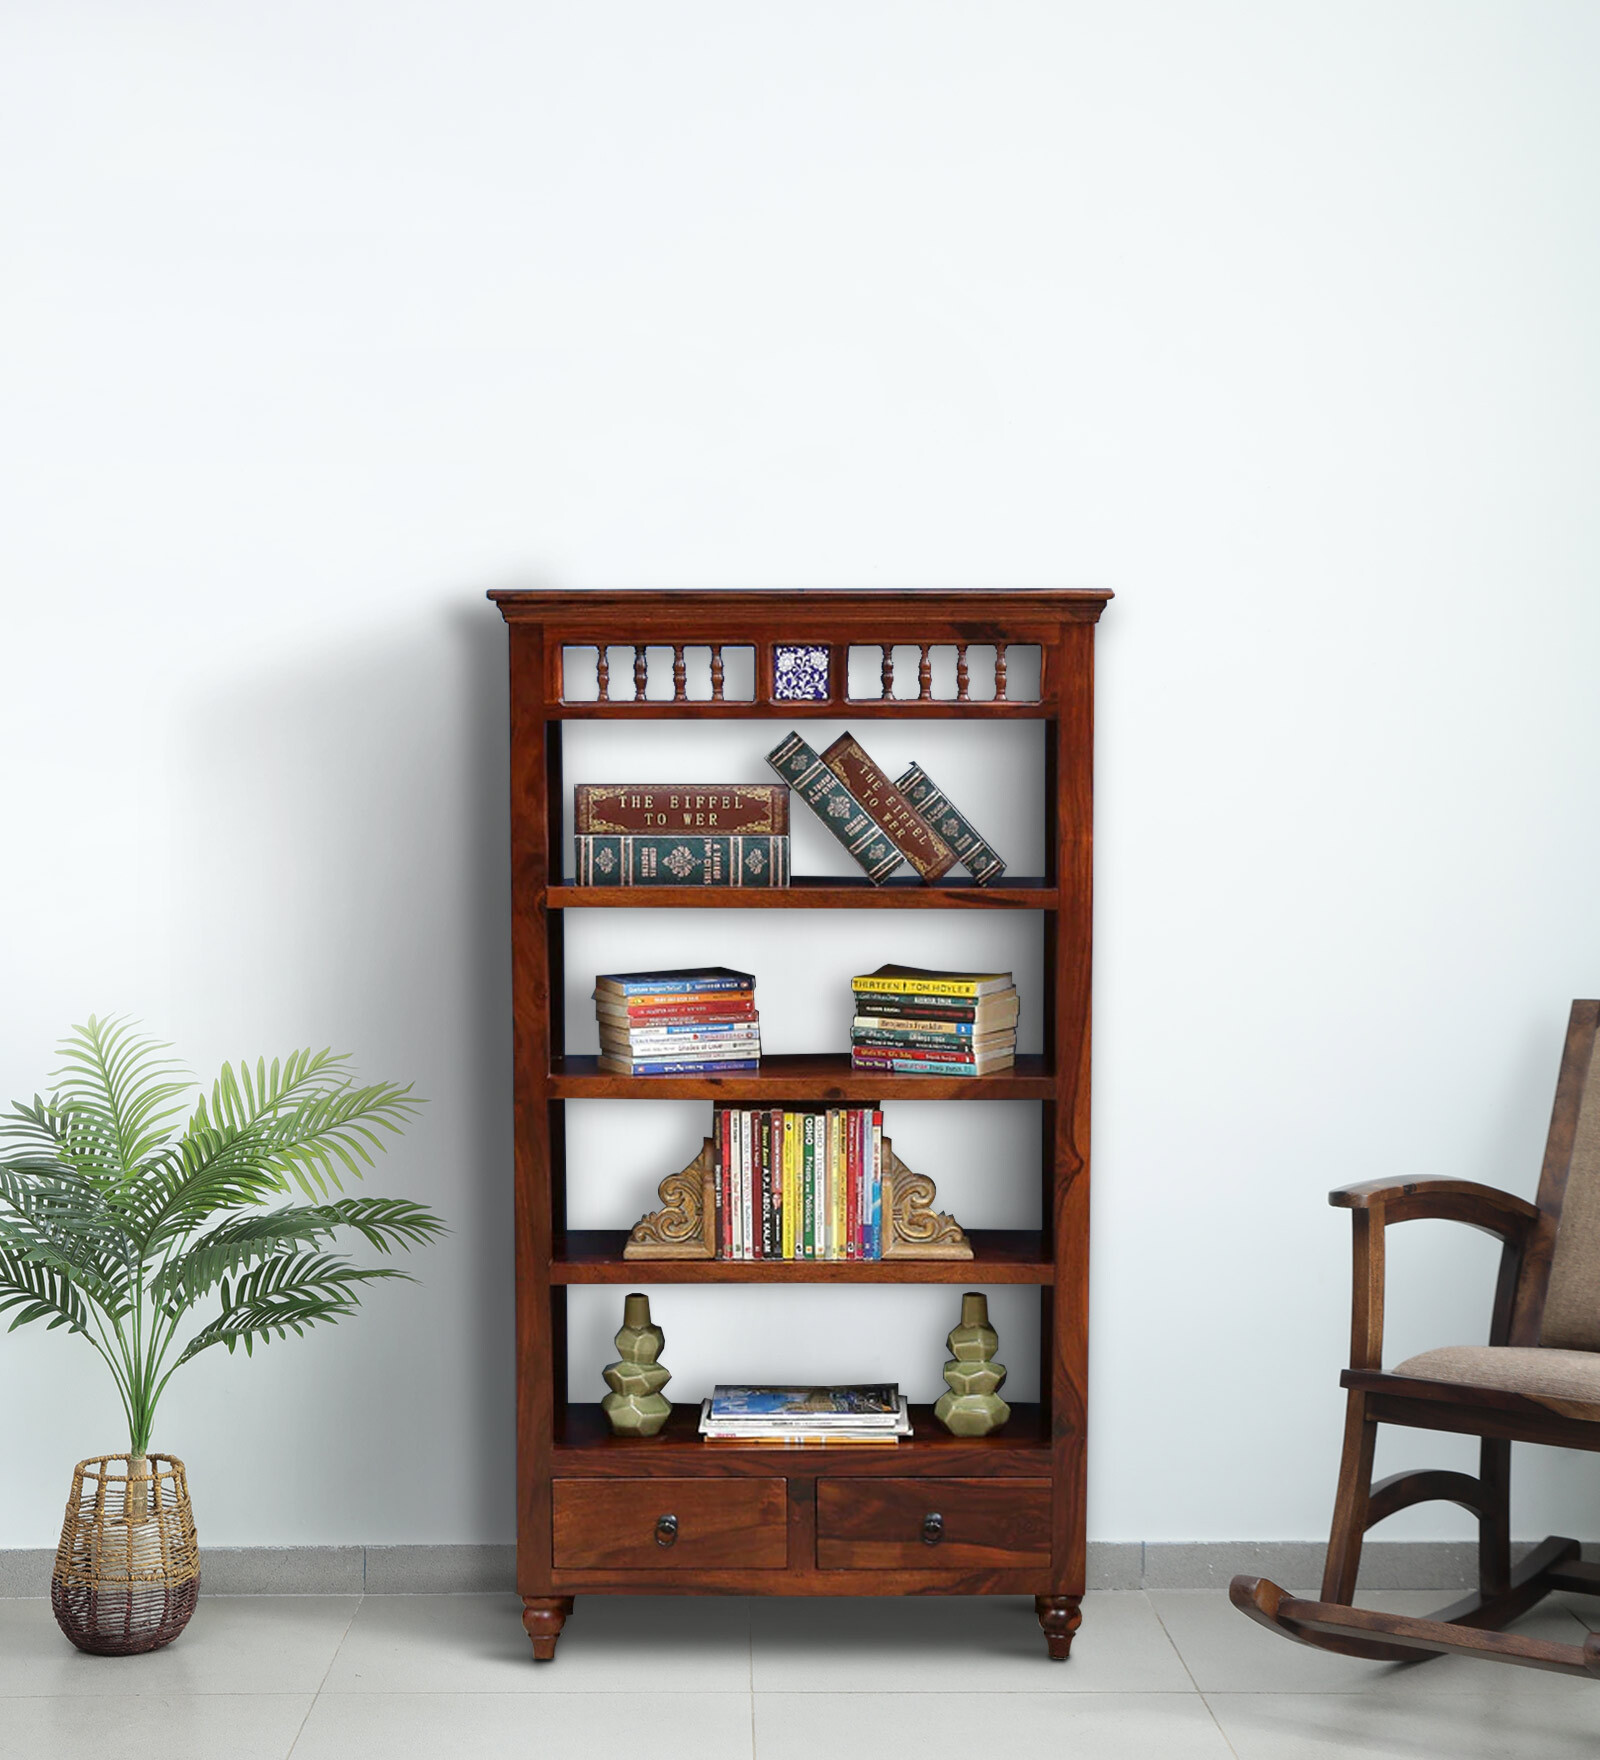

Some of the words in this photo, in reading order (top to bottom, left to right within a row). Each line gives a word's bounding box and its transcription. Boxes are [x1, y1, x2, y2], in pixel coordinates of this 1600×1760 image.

[618, 795, 654, 809] THE
[670, 795, 744, 809] EIFFEL
[858, 764, 883, 792] THE
[885, 797, 929, 846] EIFFEL
[861, 789, 879, 809] TO
[881, 811, 906, 840] WER
[644, 812, 667, 826] TO
[683, 812, 718, 826] WER
[853, 980, 900, 991] THIRTEEN
[881, 1020, 914, 1030] Benjamin
[914, 1021, 943, 1031] Franklin
[805, 1118, 813, 1145] OSHO
[762, 1192, 770, 1221] ABDUL
[763, 1223, 771, 1253] KALAM
